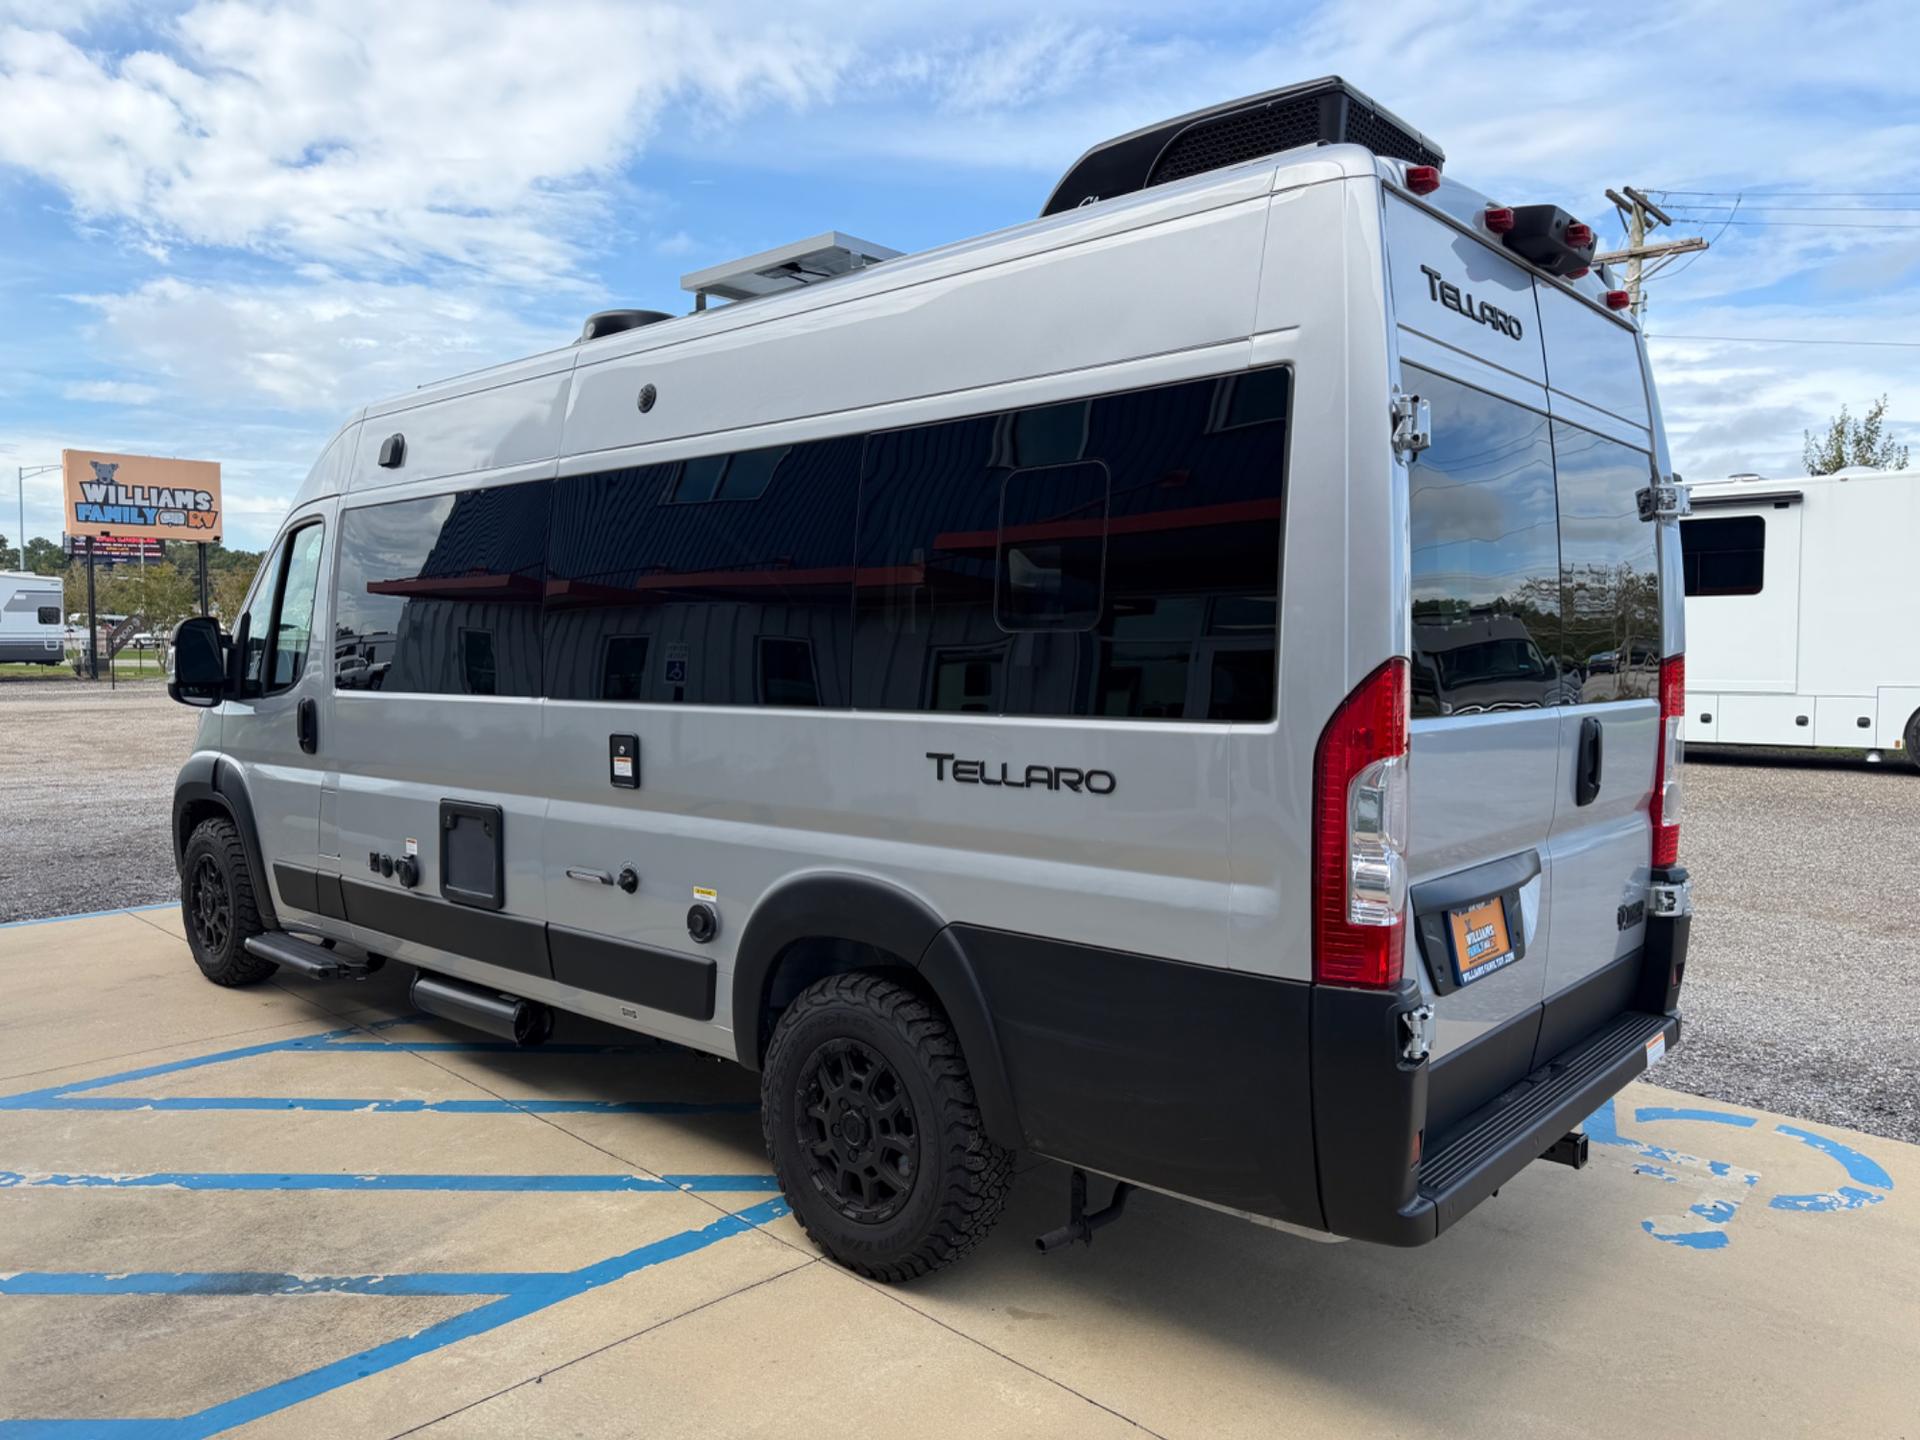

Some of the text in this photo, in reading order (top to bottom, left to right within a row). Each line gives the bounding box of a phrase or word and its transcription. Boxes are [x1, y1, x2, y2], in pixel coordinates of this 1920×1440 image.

[1420, 264, 1523, 341] TELLARO
[80, 481, 214, 511] WILLIAMS
[75, 502, 219, 529] FAMILY RV
[926, 752, 1117, 795] TELLARO
